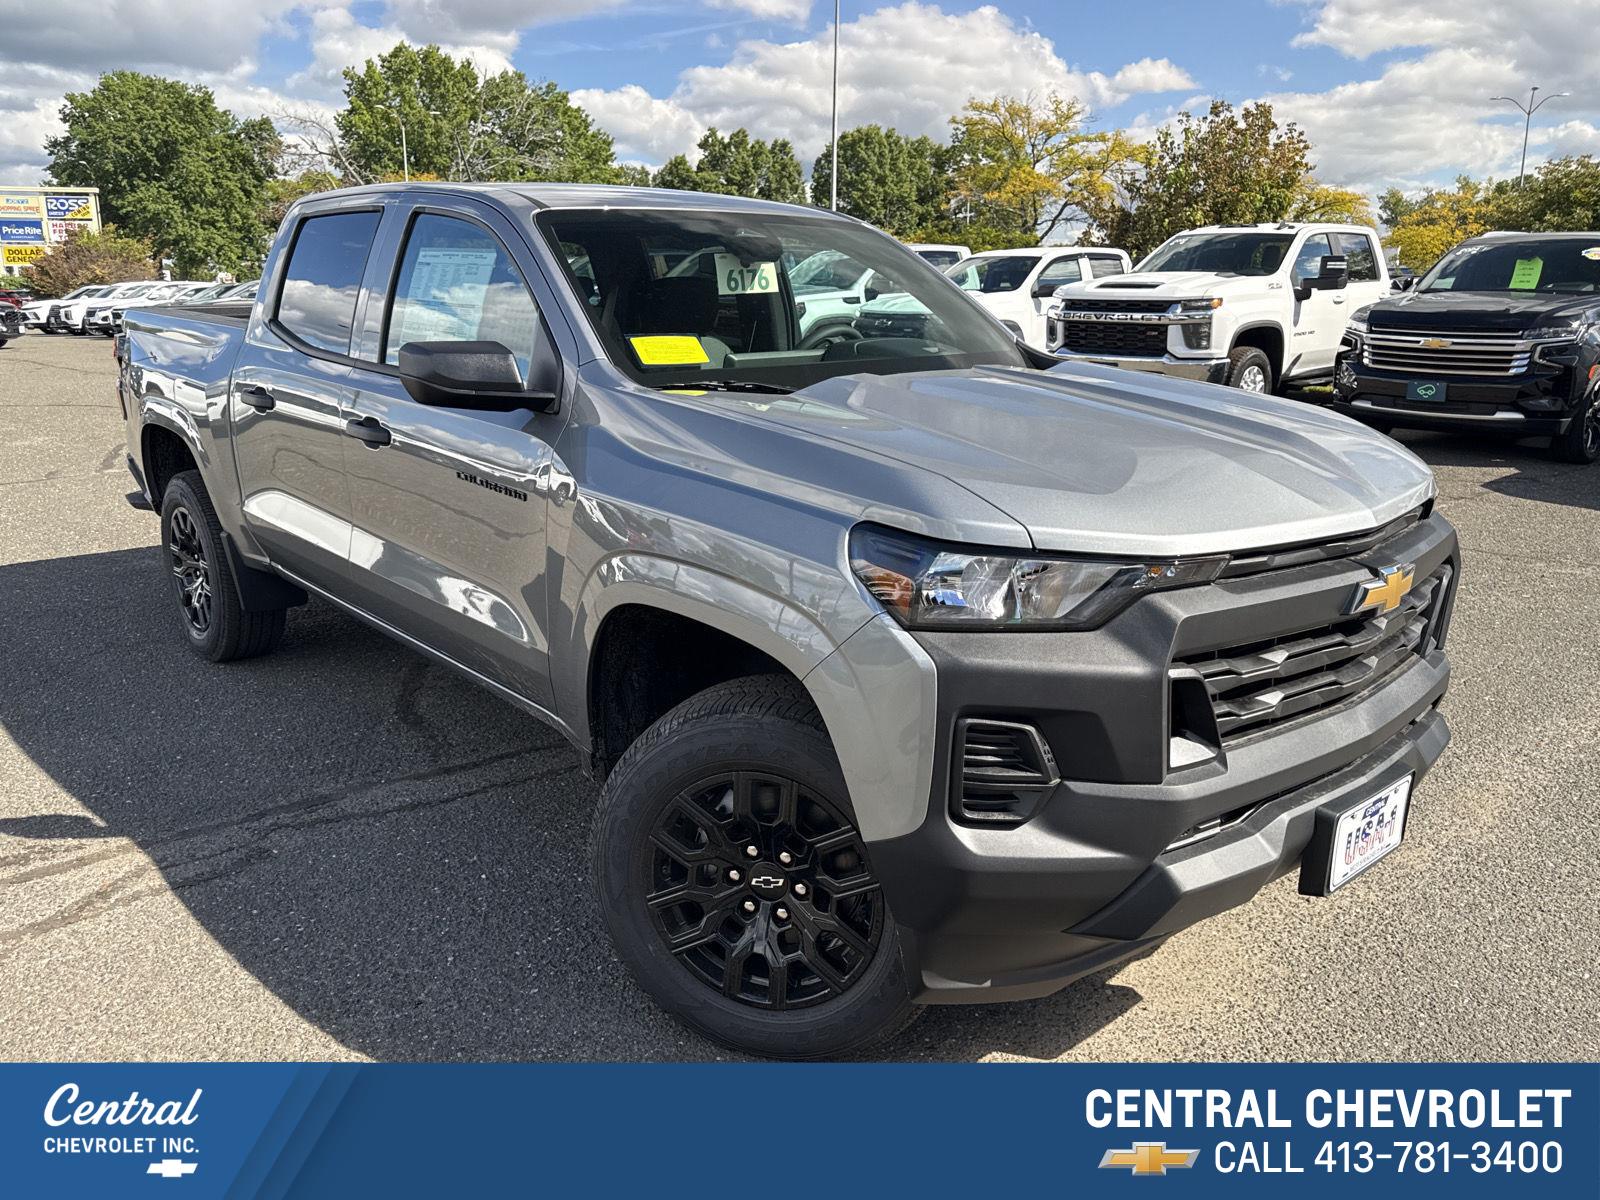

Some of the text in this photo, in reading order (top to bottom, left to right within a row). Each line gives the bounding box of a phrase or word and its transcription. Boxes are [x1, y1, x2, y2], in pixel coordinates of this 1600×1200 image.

[47, 199, 88, 210] ROSS
[2, 225, 24, 235] Price
[25, 226, 42, 235] Rite
[8, 248, 42, 256] DOLLAR
[726, 268, 770, 292] 6176
[1063, 312, 1169, 321] CHEVROLET
